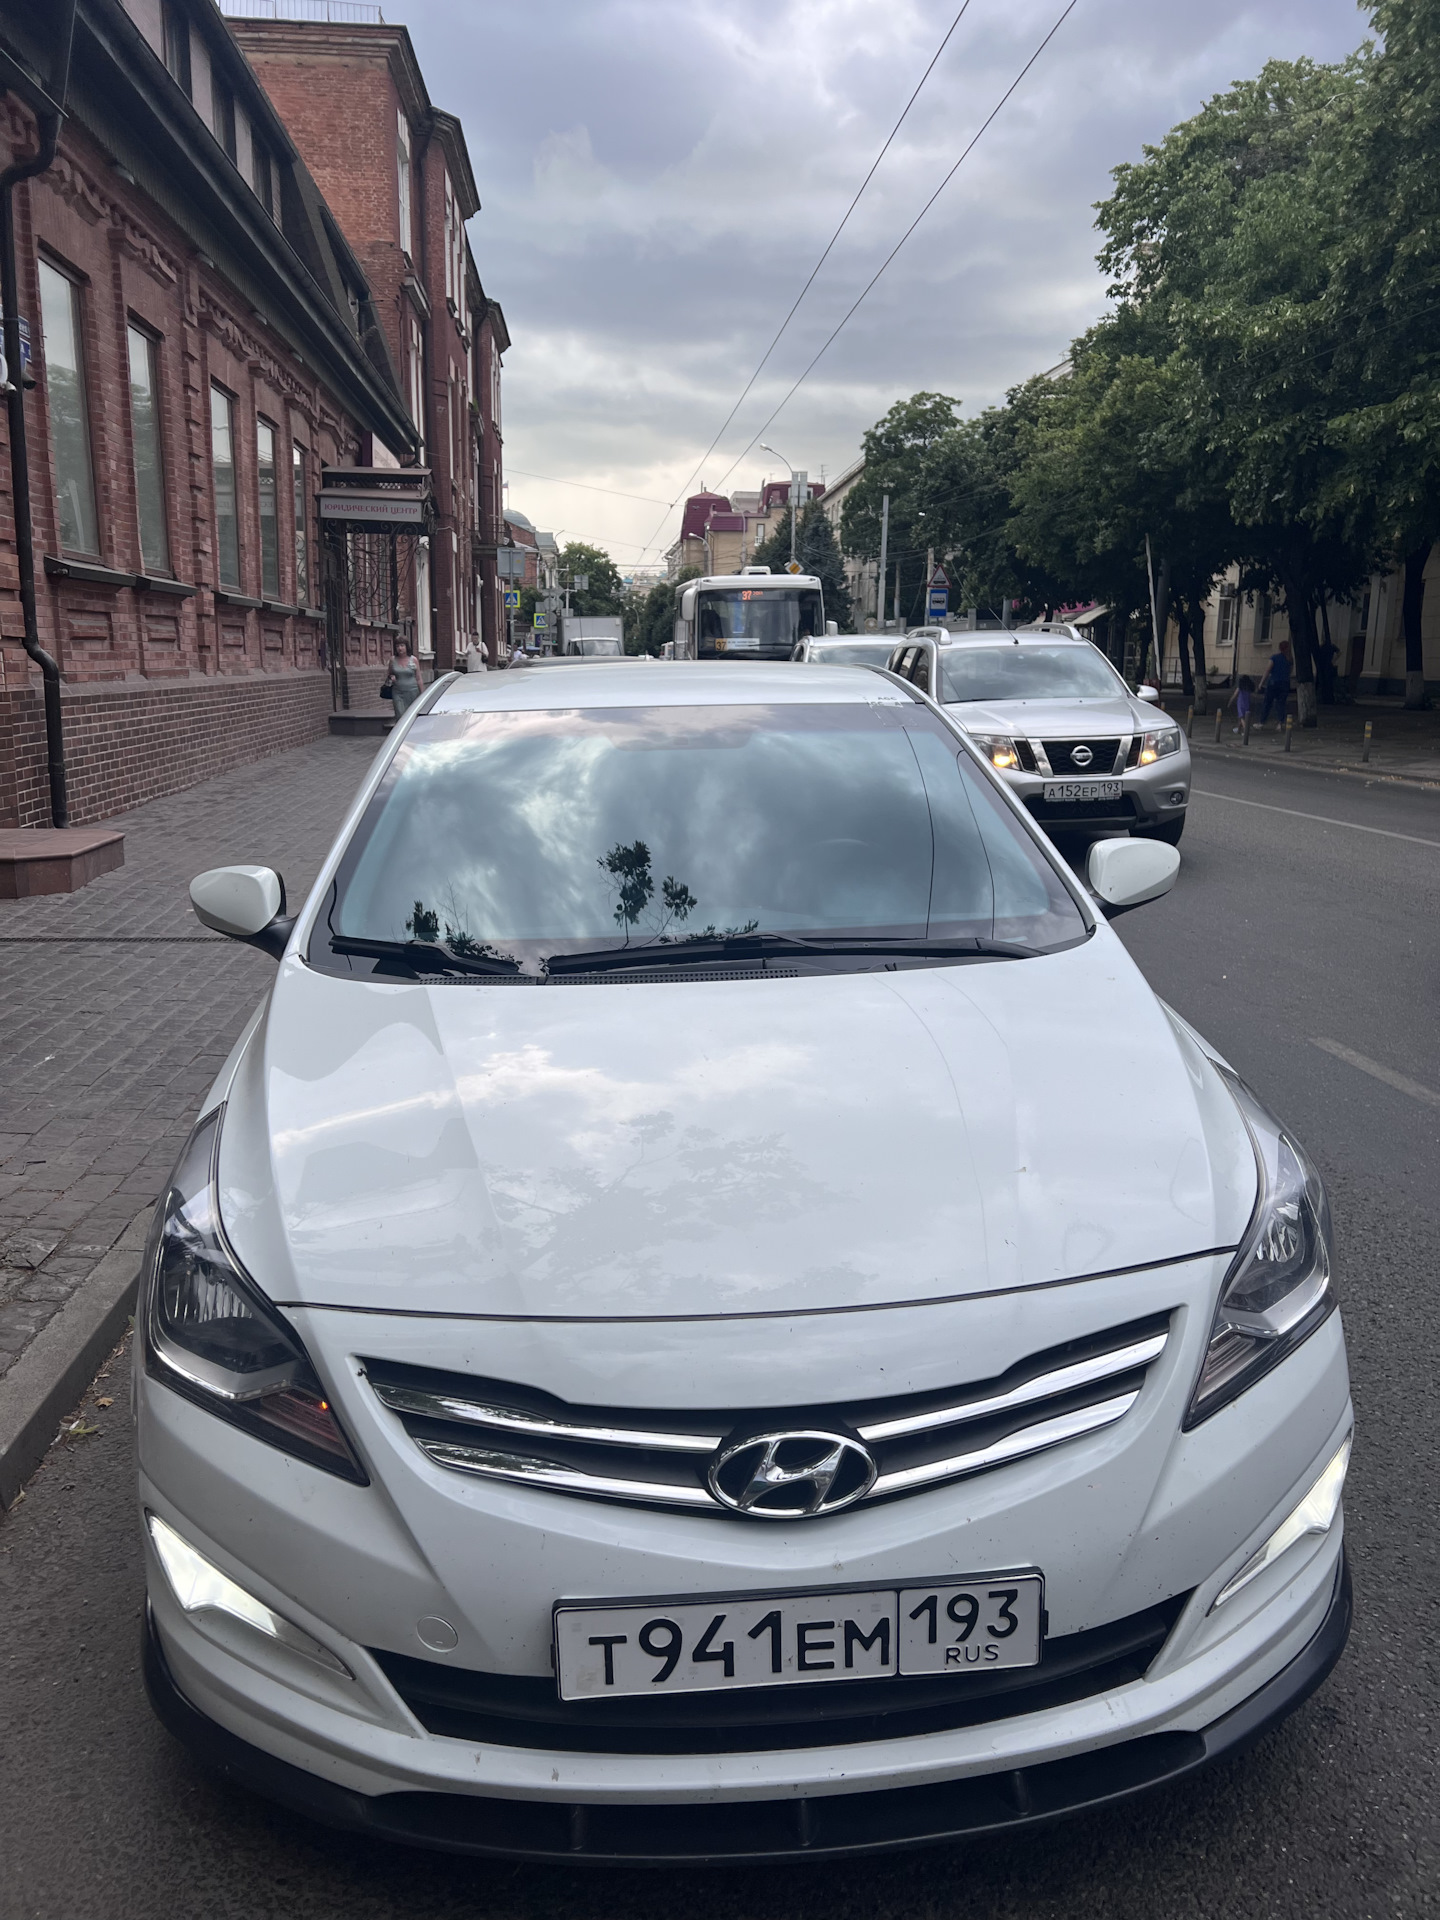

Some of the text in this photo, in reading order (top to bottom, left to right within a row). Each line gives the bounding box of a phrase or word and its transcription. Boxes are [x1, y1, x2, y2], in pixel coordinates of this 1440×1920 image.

[324, 503, 418, 515] ЮРИДИЧЕСКИЙ ЦЕНТР
[742, 590, 752, 600] 37
[716, 641, 727, 651] 37
[1048, 782, 1119, 798] А152ЕР 193
[588, 1588, 1020, 1685] Т941ЕМ 193
[945, 1643, 1000, 1665] RUS
